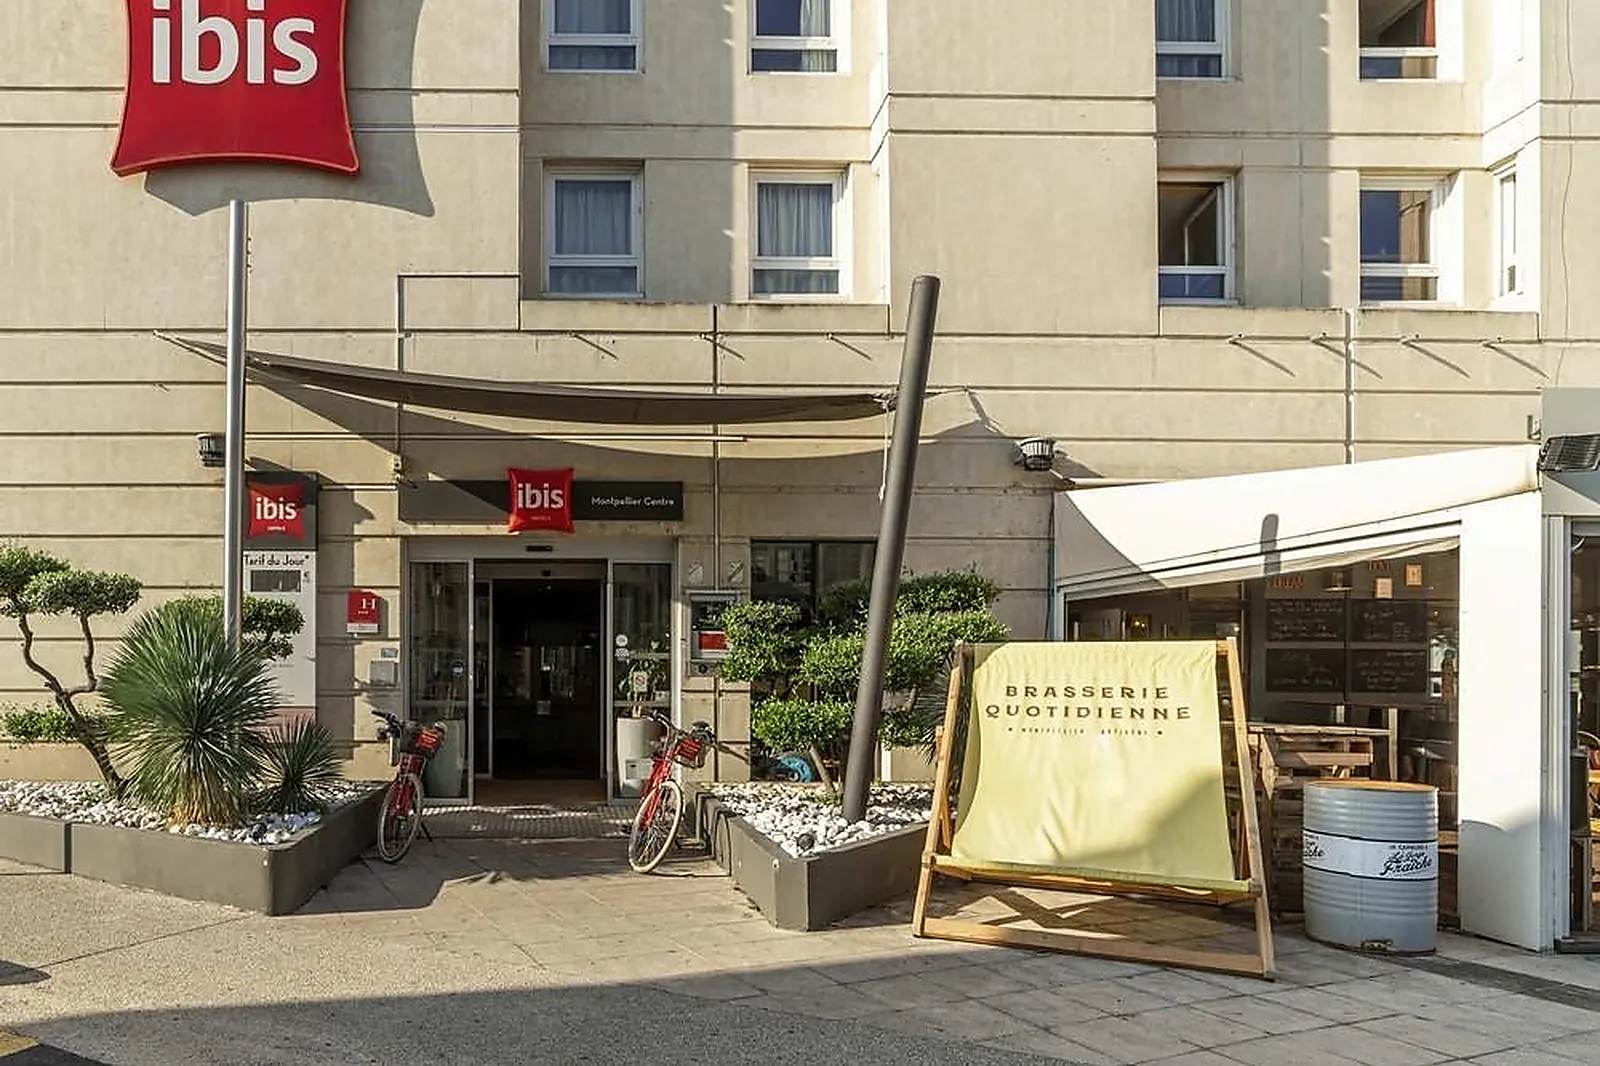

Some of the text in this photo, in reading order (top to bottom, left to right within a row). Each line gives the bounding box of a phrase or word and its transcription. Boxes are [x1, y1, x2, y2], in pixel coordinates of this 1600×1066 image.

[153, 0, 318, 85] ibis
[517, 483, 564, 509] ibis
[590, 496, 675, 508] Montpellier Centre
[255, 497, 298, 520] ibis
[266, 554, 281, 567] du
[1005, 685, 1169, 700] BRASSERIE
[985, 704, 1192, 721] QUOTIDIENNE
